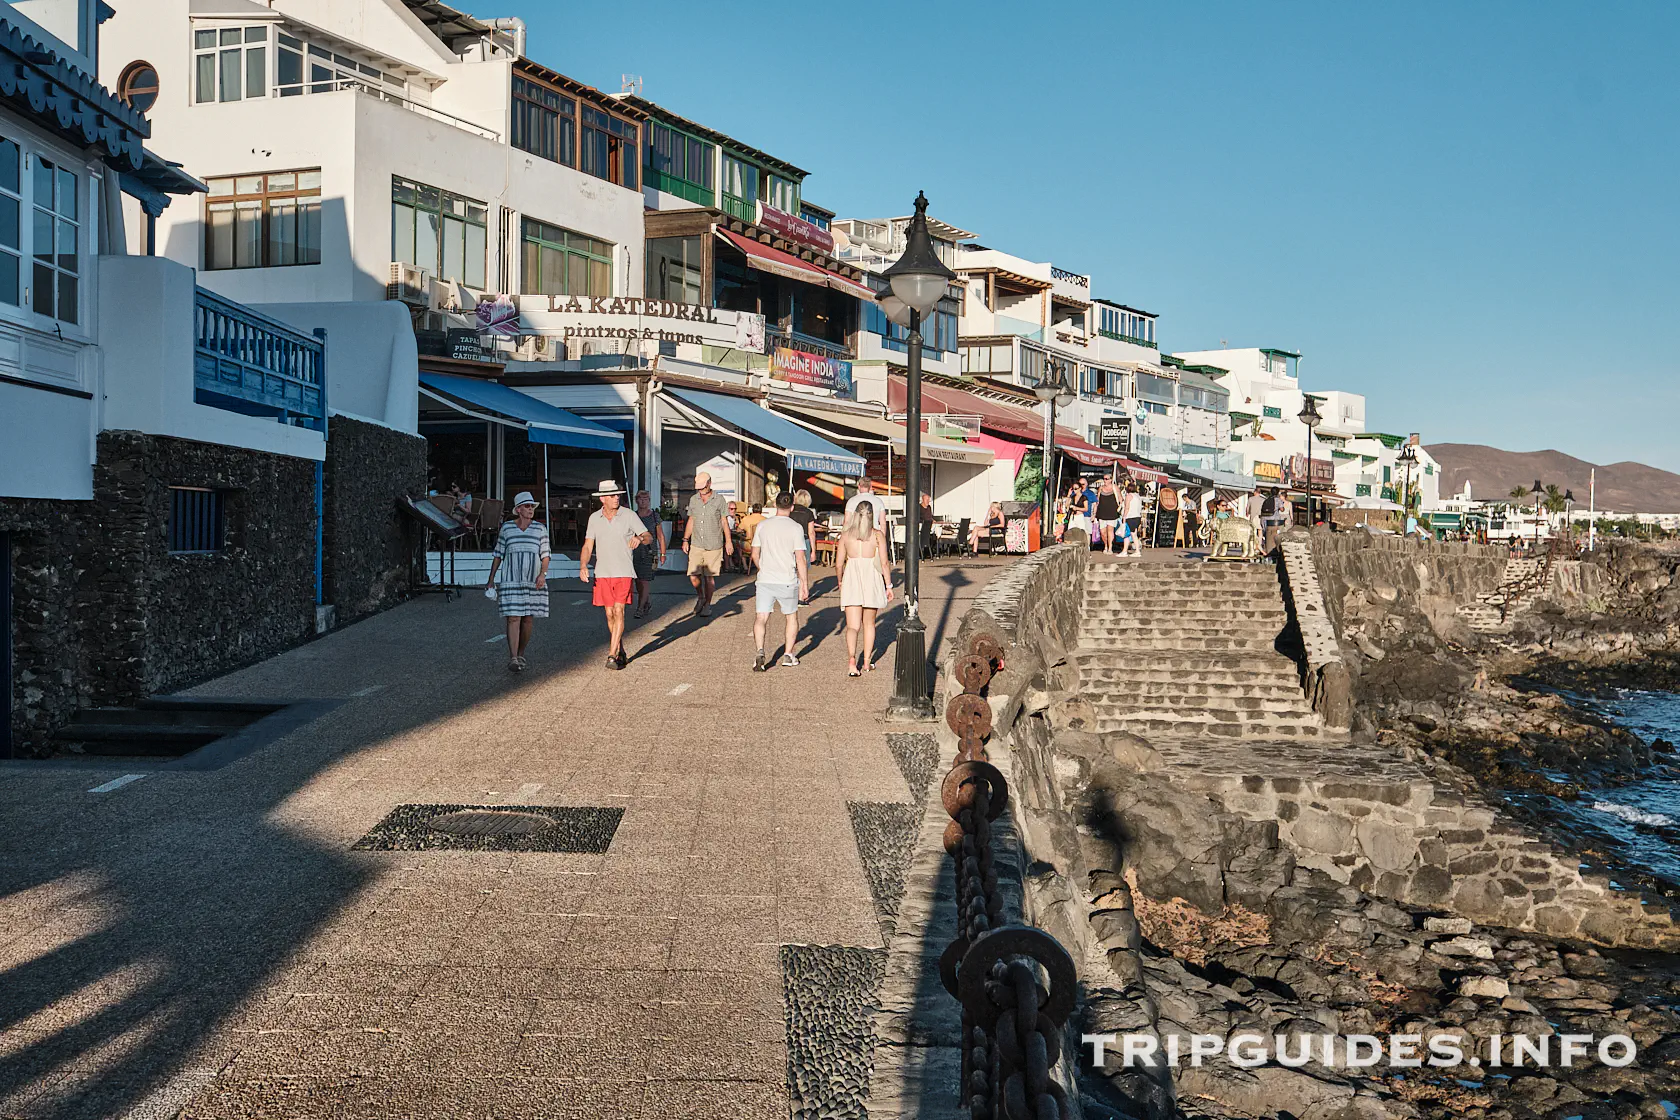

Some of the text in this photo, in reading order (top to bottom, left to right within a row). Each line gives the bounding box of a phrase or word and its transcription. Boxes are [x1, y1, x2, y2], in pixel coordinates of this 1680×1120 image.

[548, 294, 718, 324] LA KATEDRAL
[563, 322, 704, 346] pintxos & tapas
[773, 351, 835, 378] IMAGINE INDIA
[1103, 426, 1128, 437] BODEGÓN
[927, 448, 967, 461] INDIAN RESTAURANT
[804, 458, 838, 471] KATEDRAL
[840, 463, 860, 474] TAPAS
